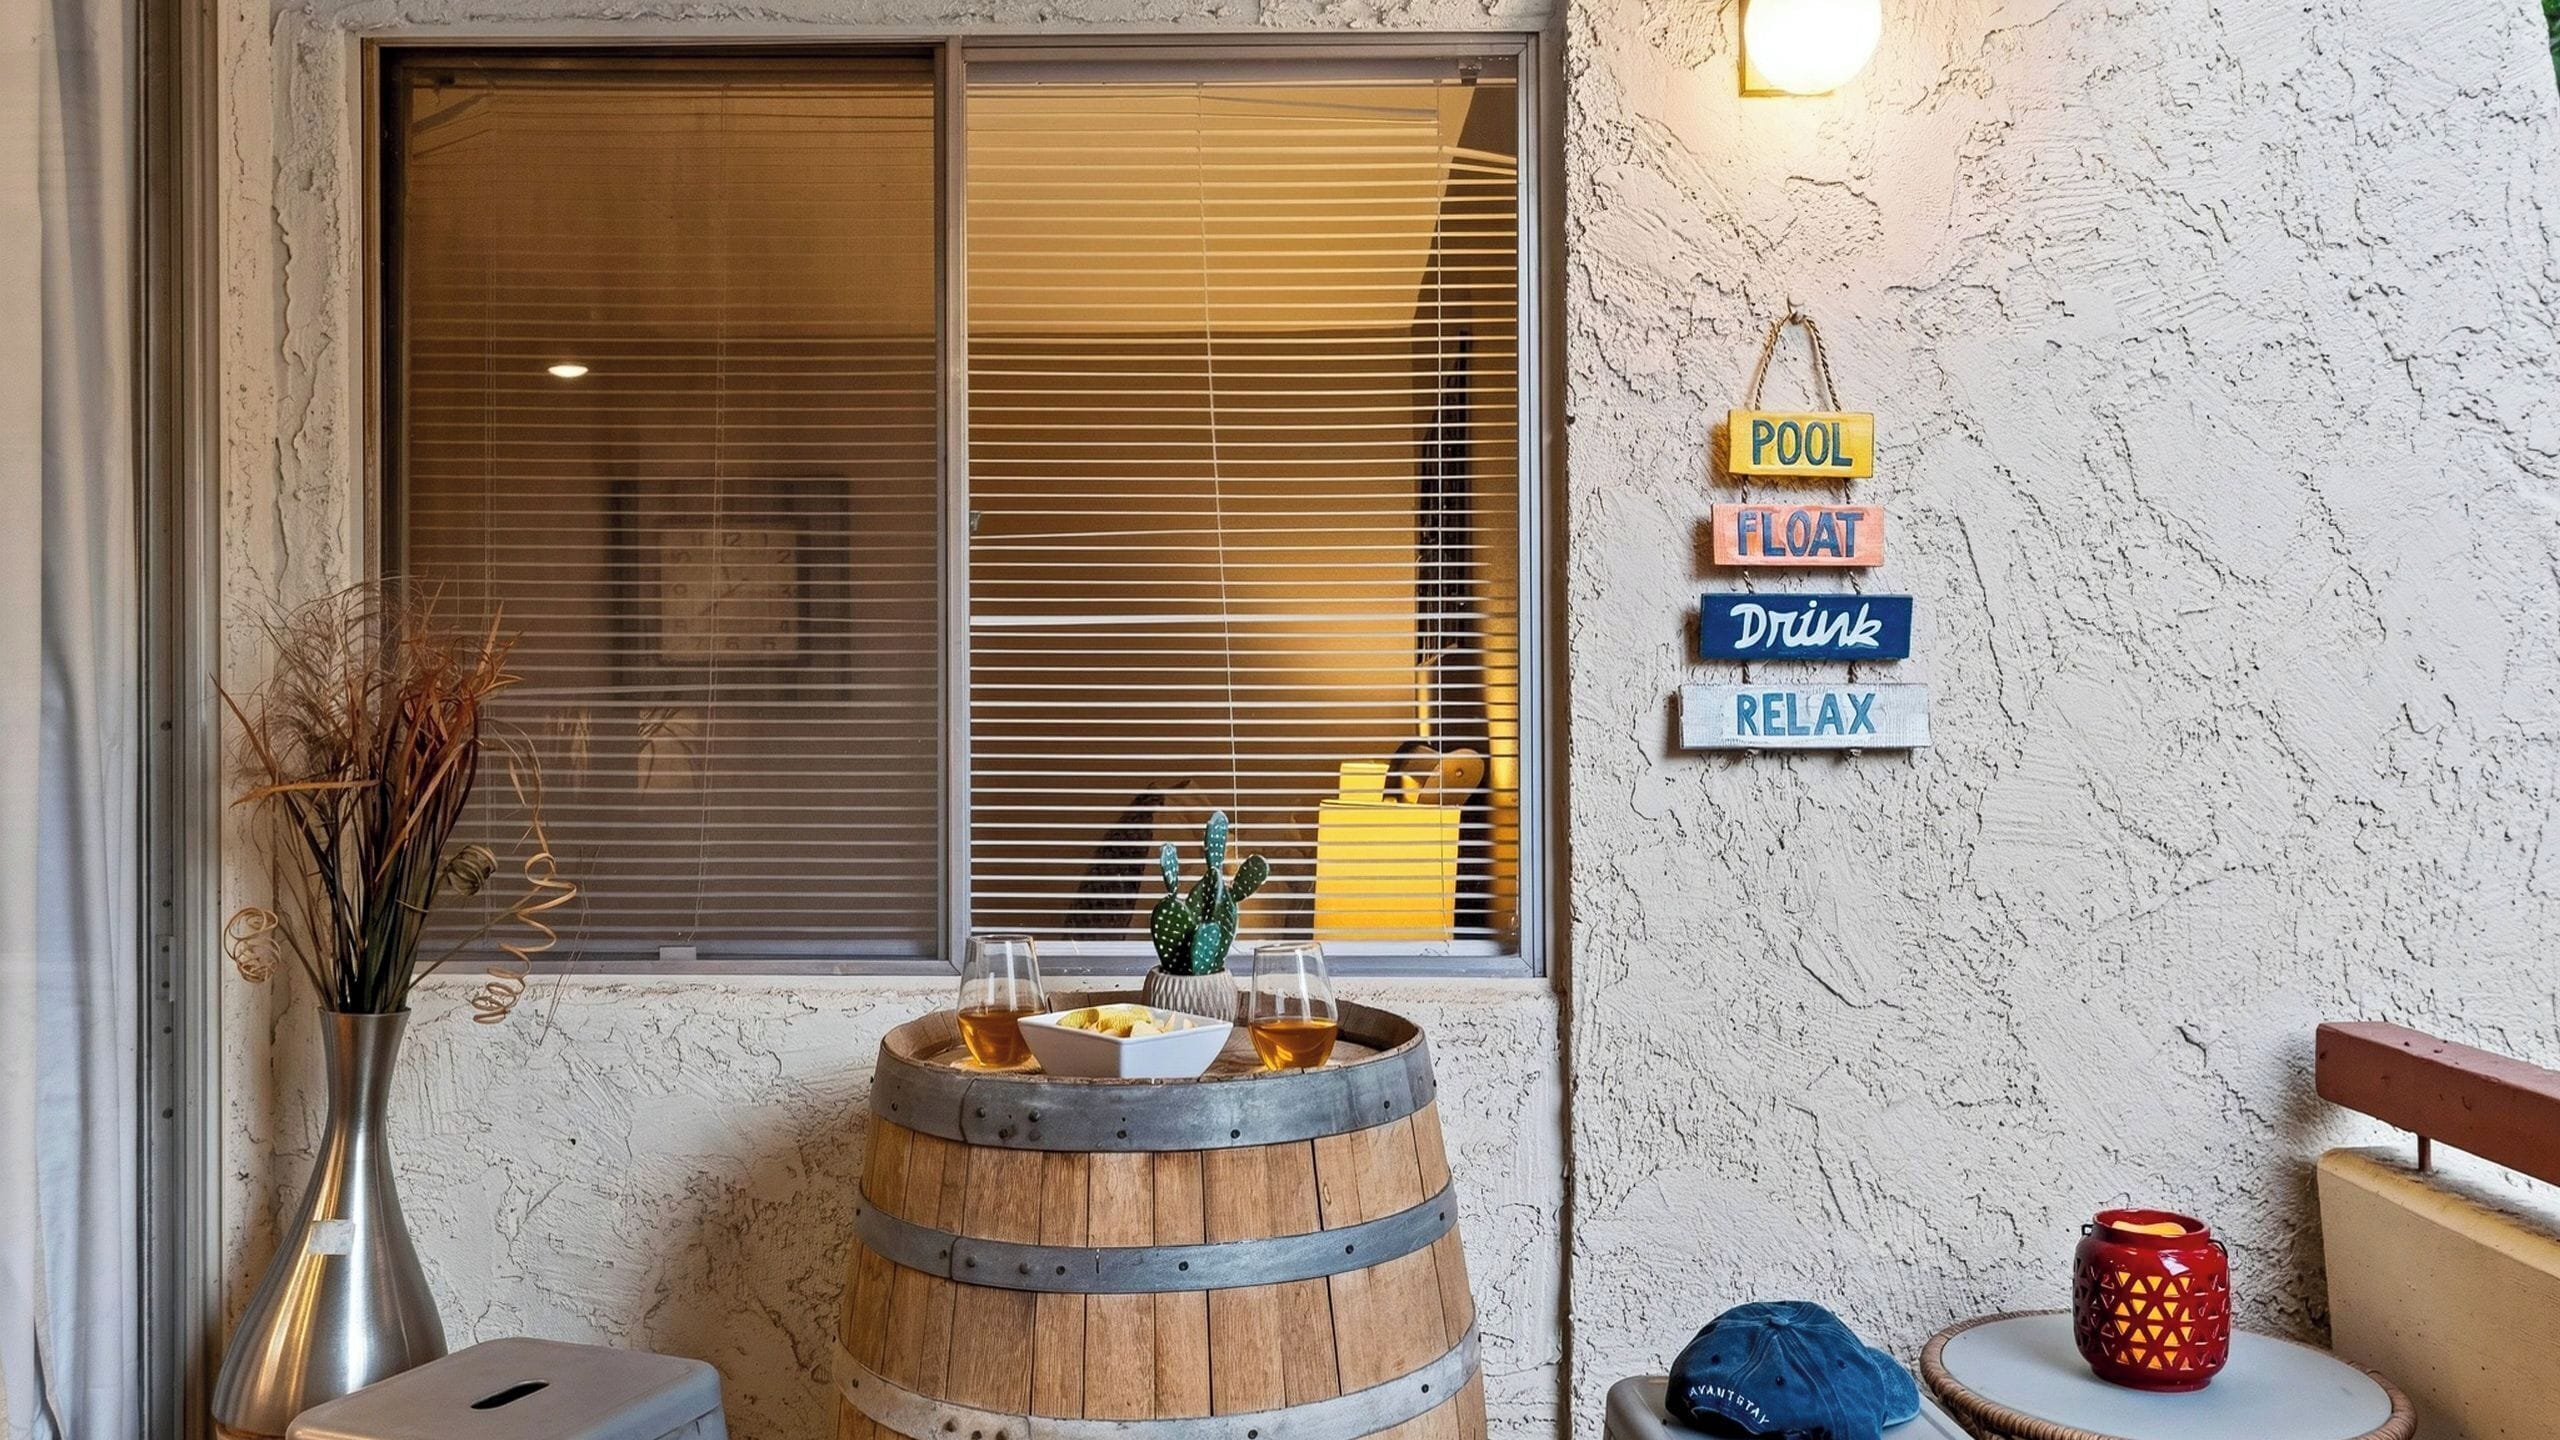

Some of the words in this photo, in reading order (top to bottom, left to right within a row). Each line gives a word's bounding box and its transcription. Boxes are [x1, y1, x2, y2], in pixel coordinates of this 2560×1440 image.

[1752, 419, 1854, 467] POOL
[721, 531, 741, 547] 12
[1737, 509, 1865, 558] FLOAT
[1730, 600, 1883, 649] Drink
[1736, 692, 1877, 737] RELAX
